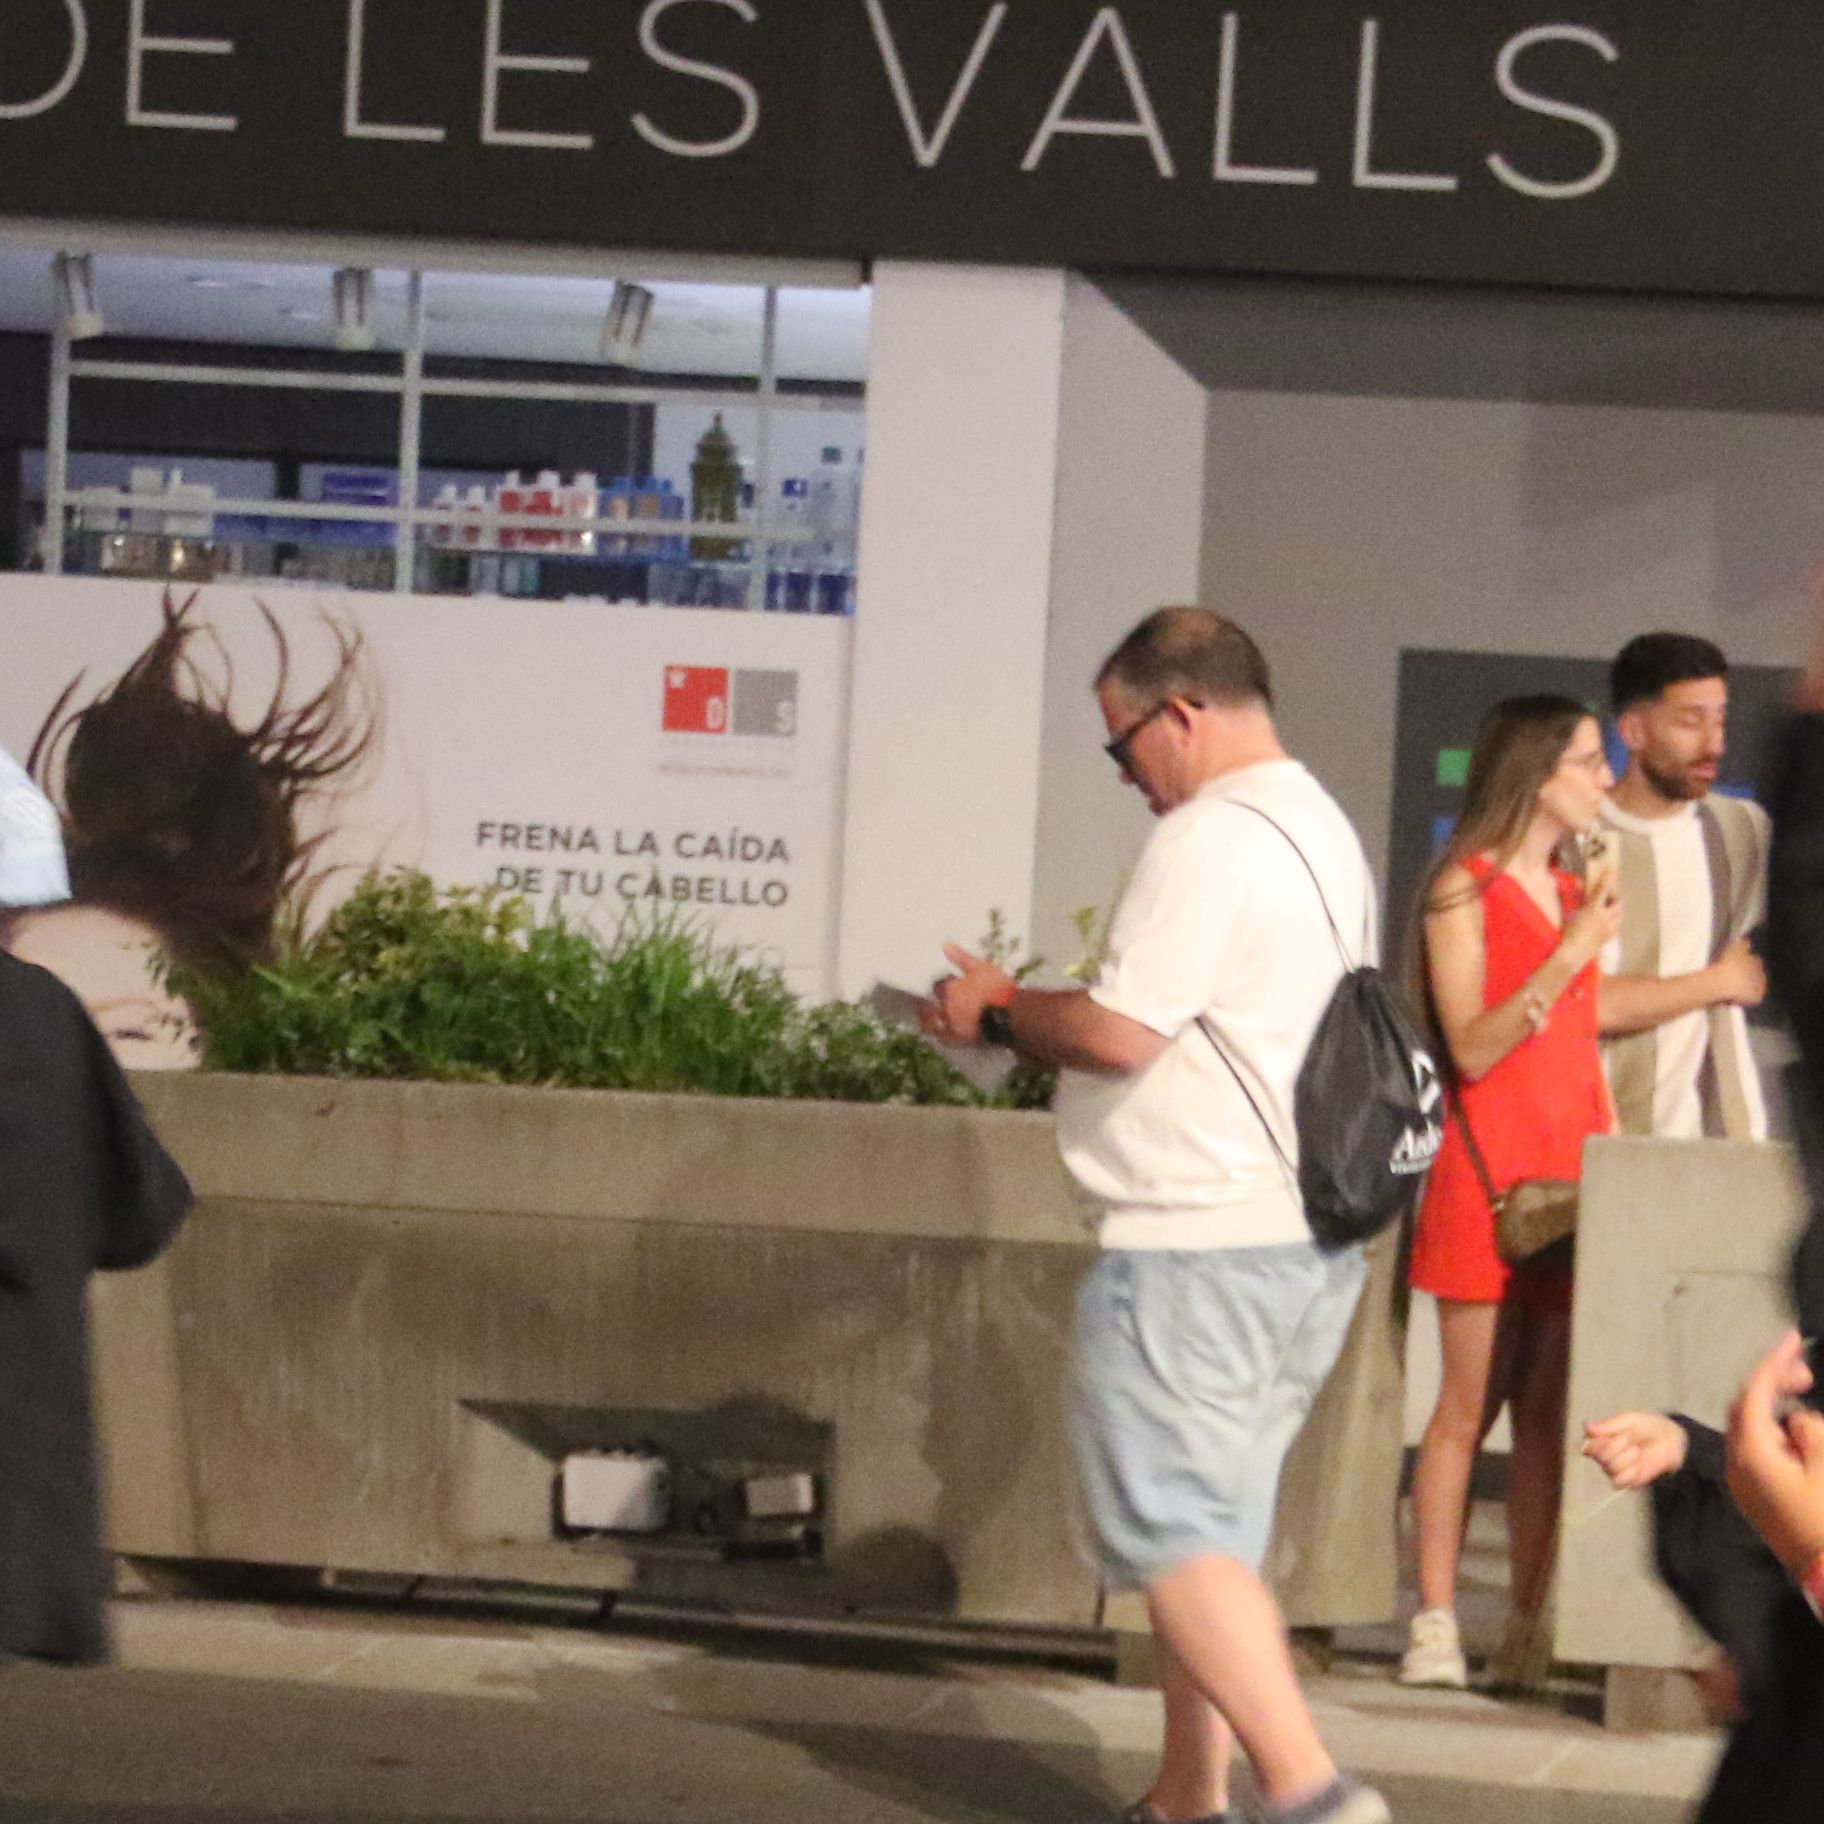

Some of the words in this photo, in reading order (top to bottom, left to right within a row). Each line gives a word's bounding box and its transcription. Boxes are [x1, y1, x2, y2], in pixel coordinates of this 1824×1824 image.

[344, 0, 760, 157] LES
[866, 0, 1620, 198] VALLS
[476, 820, 600, 854] FRENA
[614, 828, 659, 858] LA
[673, 826, 791, 865] CAÍDA
[496, 864, 543, 895] DE
[556, 868, 604, 898] TU
[615, 870, 789, 907] CABELLO
